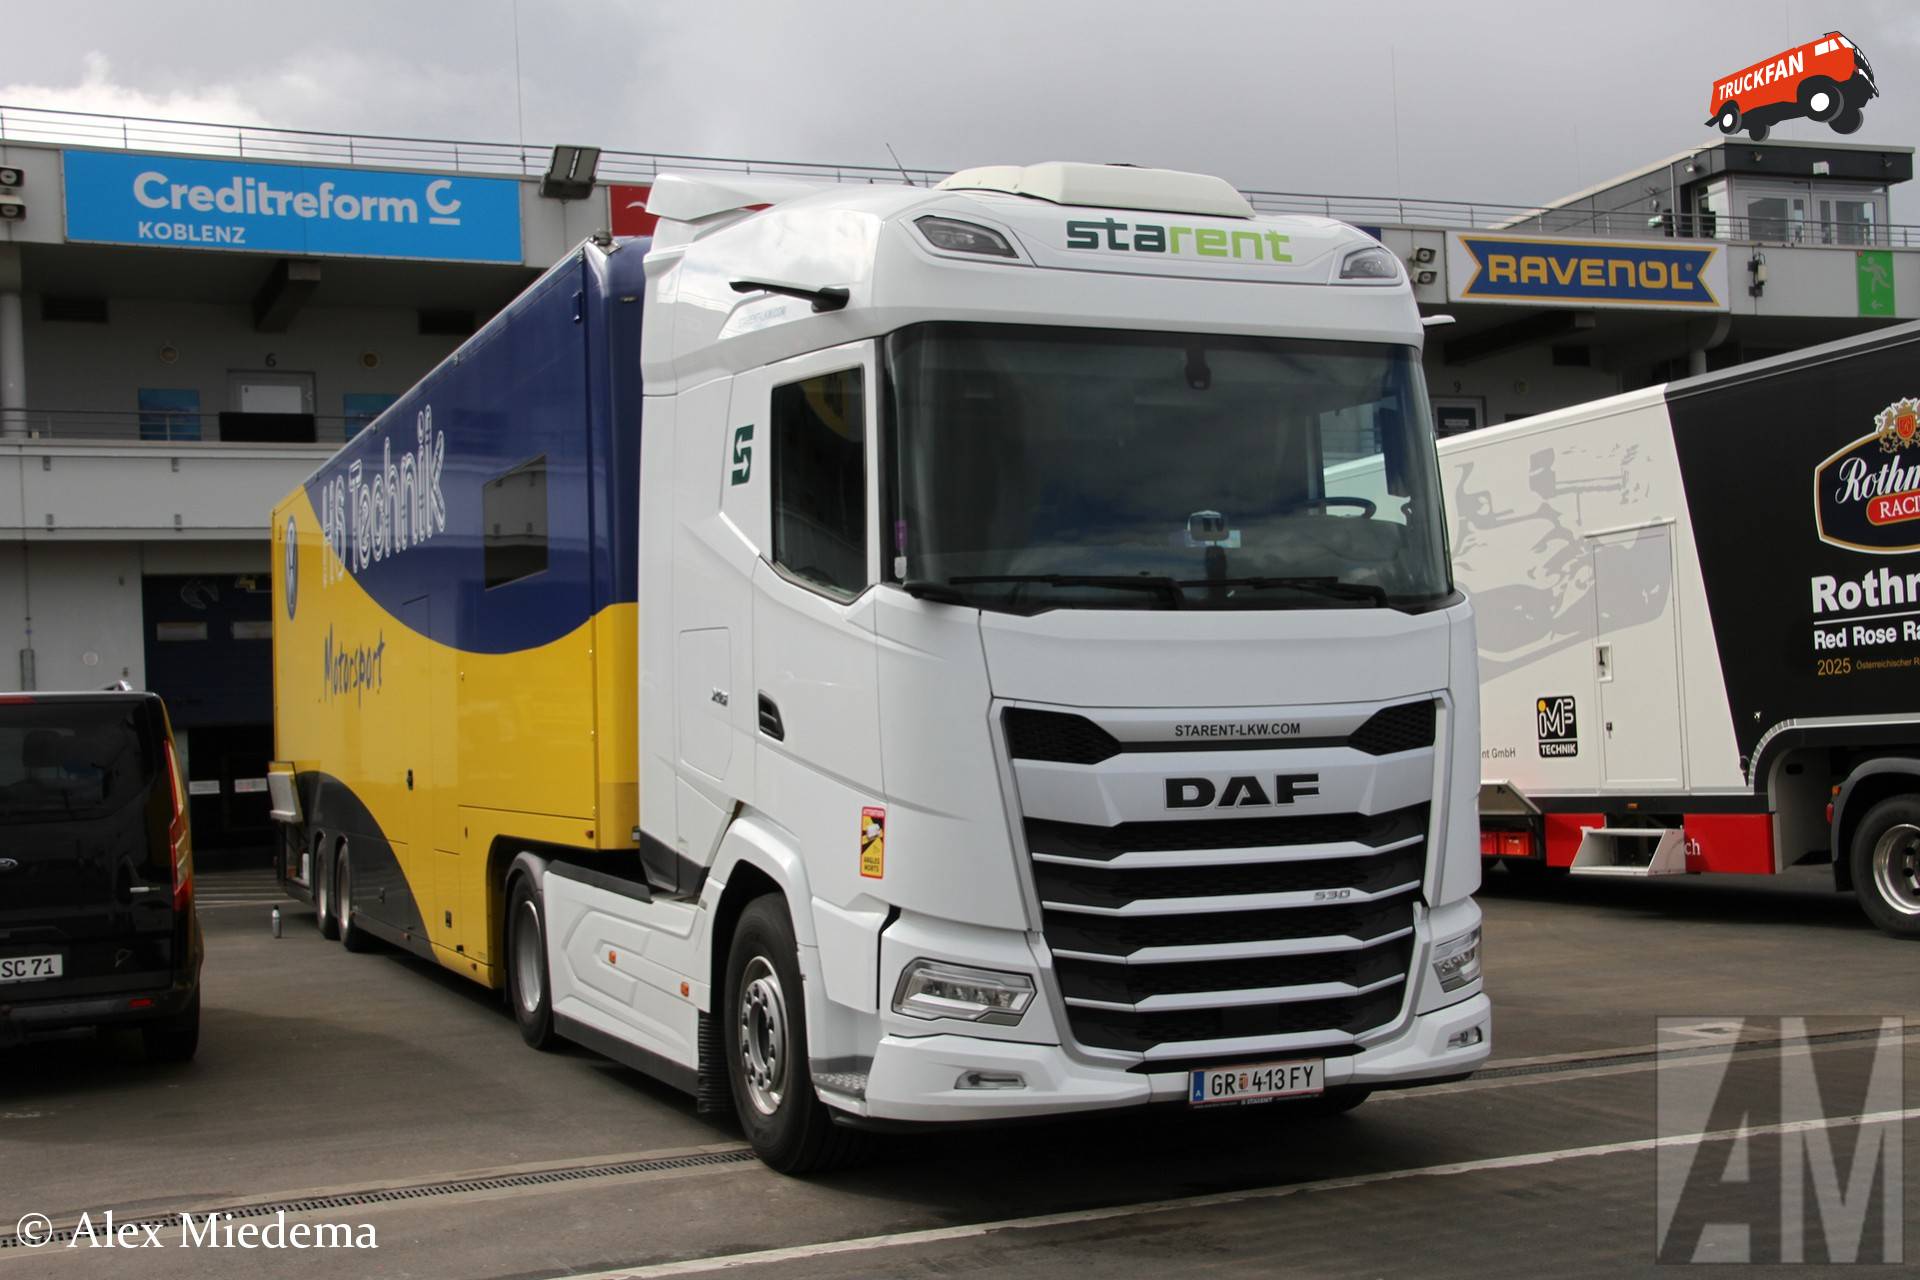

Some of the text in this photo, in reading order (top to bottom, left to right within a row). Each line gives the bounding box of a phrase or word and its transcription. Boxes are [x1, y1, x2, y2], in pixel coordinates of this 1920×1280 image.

[133, 171, 418, 223] Creditreform
[138, 221, 246, 244] KOBLENZ
[1066, 217, 1293, 263] starent
[1488, 254, 1693, 290] RAVENOL
[265, 352, 277, 368] 6
[349, 404, 446, 574] Technik
[1879, 494, 1920, 519] RACI
[1814, 627, 1847, 650] Red
[1853, 625, 1897, 646] Rose
[323, 622, 385, 709] Motorsport
[1817, 658, 1851, 676] 2025
[1175, 723, 1300, 737] STARENT-LKW.COM
[1491, 748, 1516, 759] GmbH
[1541, 744, 1576, 755] TECHNIK
[1165, 772, 1320, 809] DAF
[1, 957, 55, 978] SC 71
[1211, 1073, 1236, 1096] GR
[1290, 1065, 1314, 1089] FY
